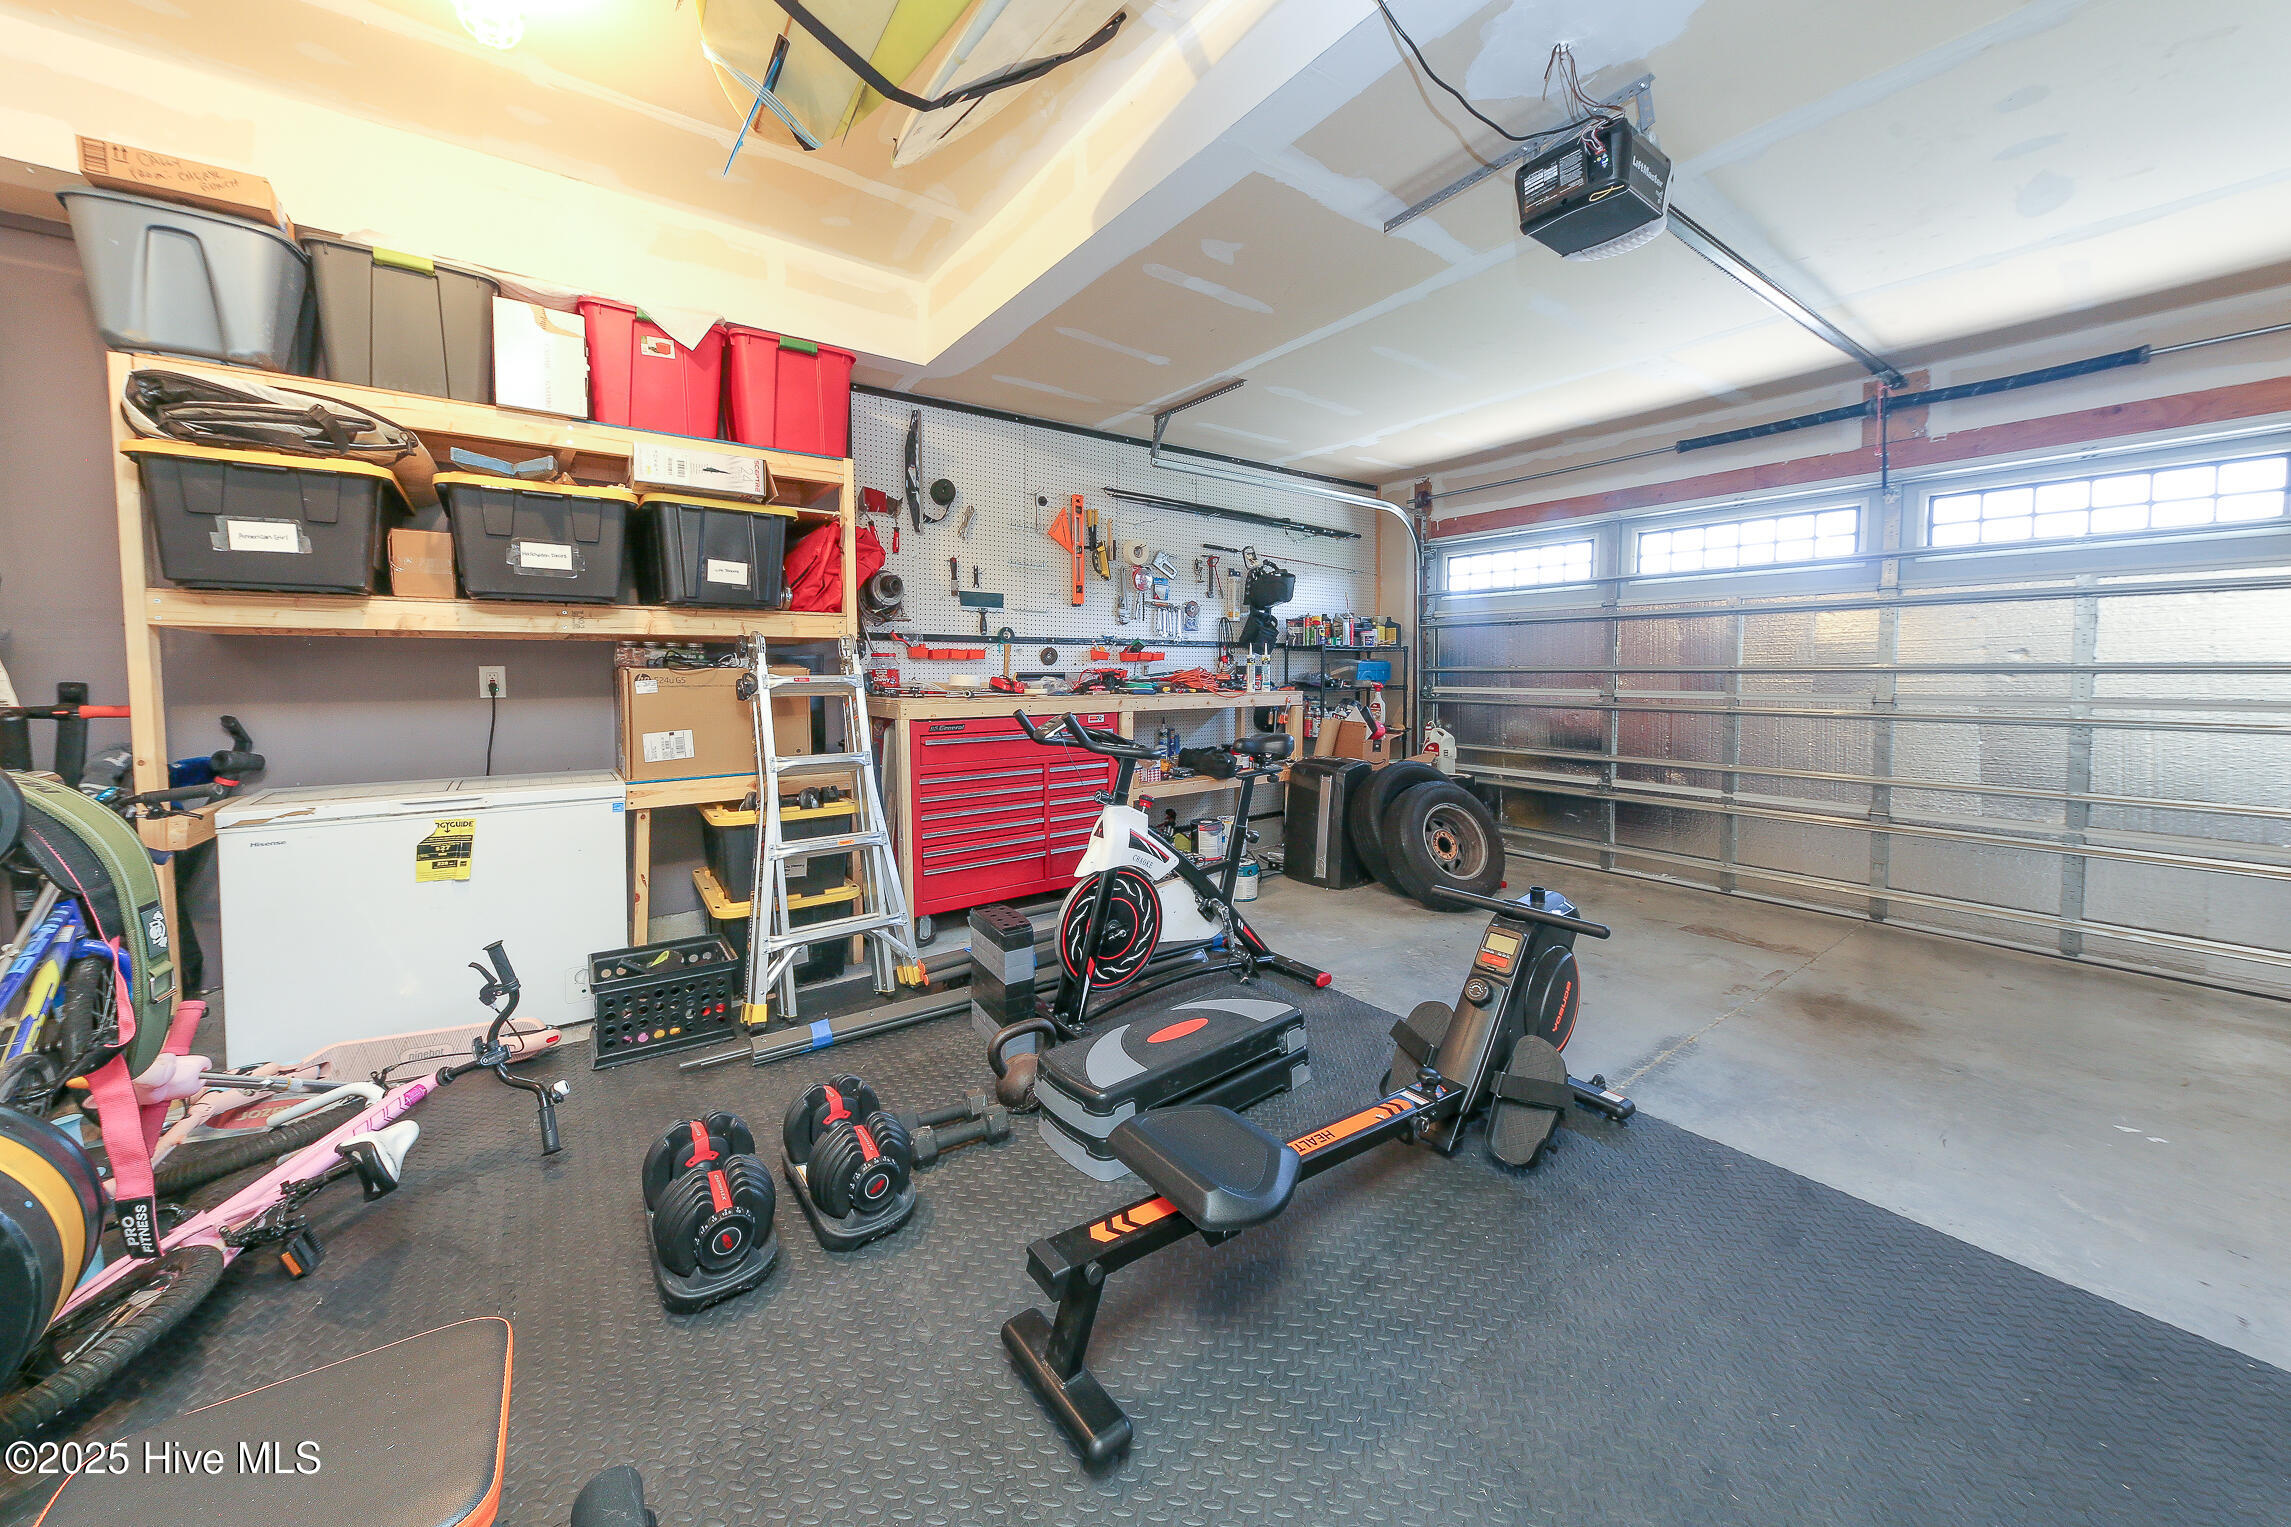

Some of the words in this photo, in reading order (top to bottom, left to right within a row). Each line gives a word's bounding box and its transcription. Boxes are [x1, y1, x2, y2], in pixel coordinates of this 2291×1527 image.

[1292, 1129, 1336, 1153] HEALT
[120, 1215, 141, 1247] PRO
[134, 1204, 155, 1253] FITNESS
